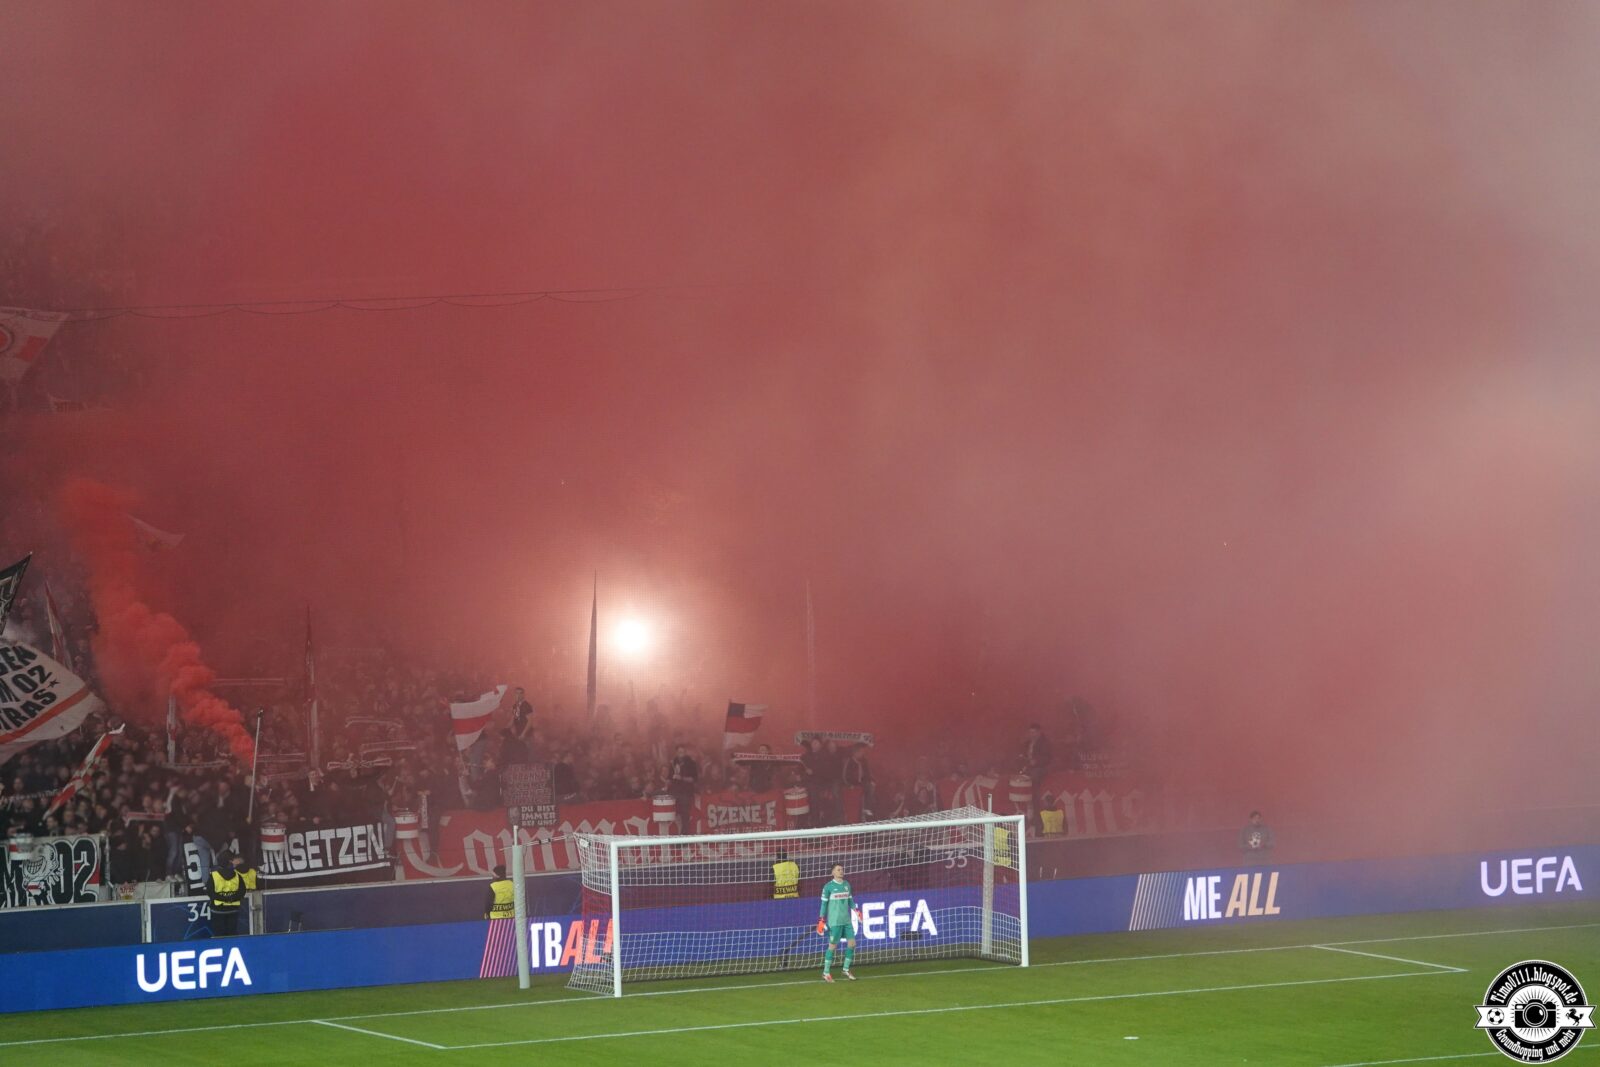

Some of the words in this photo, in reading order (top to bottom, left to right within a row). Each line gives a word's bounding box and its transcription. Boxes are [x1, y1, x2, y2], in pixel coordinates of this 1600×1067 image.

[521, 812, 556, 820] IMMER
[707, 803, 762, 828] SZENE
[944, 849, 968, 869] 35
[1480, 855, 1583, 897] UEFA
[1183, 876, 1222, 921] ME
[1224, 872, 1281, 918] ALL
[187, 902, 211, 922] 34
[136, 947, 252, 993] UEFA
